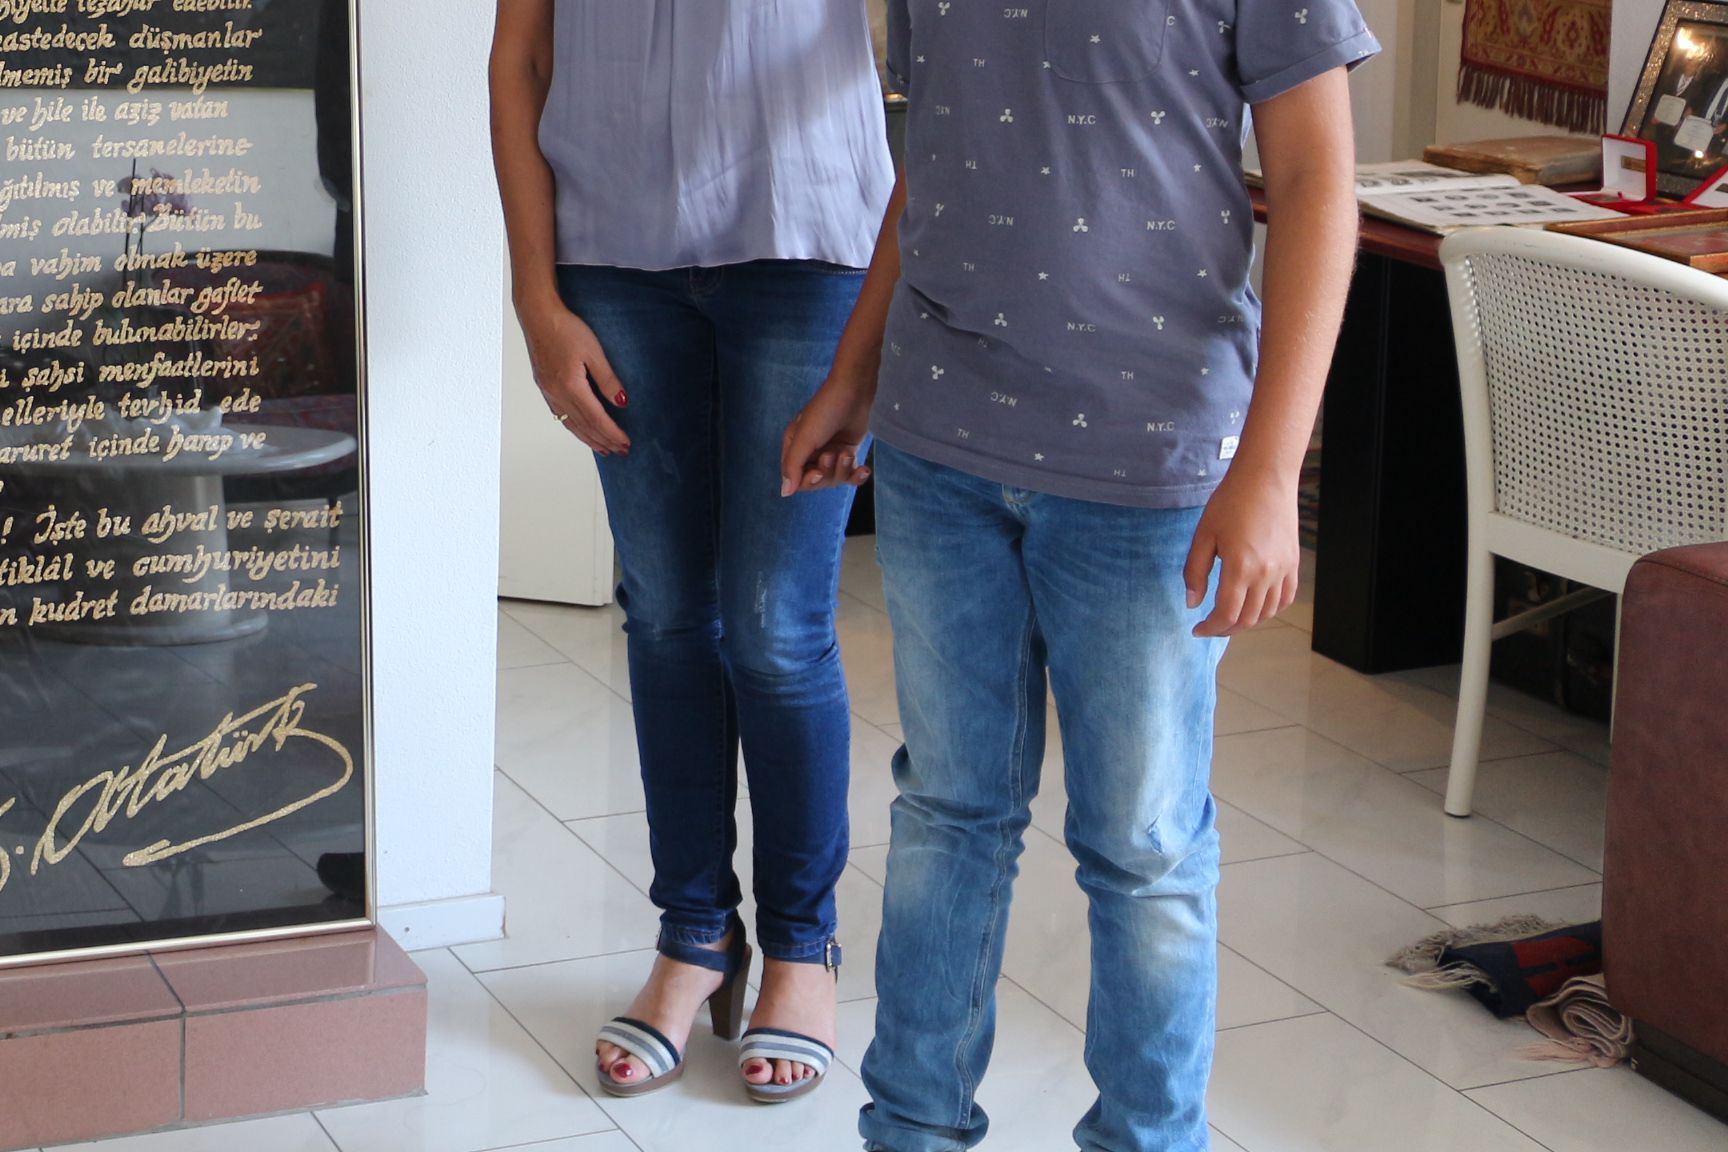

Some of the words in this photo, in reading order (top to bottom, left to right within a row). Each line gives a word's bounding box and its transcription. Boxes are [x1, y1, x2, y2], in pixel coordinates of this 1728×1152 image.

[129, 21, 263, 55] düşmanlar
[83, 57, 124, 84] bir
[972, 58, 986, 68] TH
[2, 107, 27, 125] ve
[29, 97, 73, 131] hile
[83, 96, 106, 121] ile
[115, 99, 161, 125] aziz
[170, 97, 227, 119] vatan
[1067, 114, 1097, 125] N.Y.C
[7, 136, 74, 161] bütün
[1120, 168, 1135, 178] TH
[147, 202, 224, 232] Bütün
[235, 202, 261, 228] bu
[1146, 220, 1176, 231] N.Y.C
[31, 248, 101, 280] vahim
[114, 242, 189, 272] olmak
[195, 250, 257, 274] üzere
[963, 262, 975, 272] TH
[41, 283, 104, 321] sahip
[111, 278, 195, 308] olanlar
[13, 319, 83, 354] içinde
[1066, 321, 1097, 333] N.Y.C
[21, 359, 85, 392] şahsi
[1120, 371, 1135, 381] TH
[118, 388, 203, 425] tevhid
[220, 386, 261, 414] ede
[1146, 421, 1175, 433] N.Y.C
[89, 427, 160, 462] içinde
[240, 432, 266, 449] ve
[33, 503, 87, 546] İşte
[96, 507, 131, 538] bu
[141, 505, 219, 544] ahval
[227, 511, 253, 529] ve
[264, 500, 344, 533] şerait
[27, 589, 119, 626] kudret
